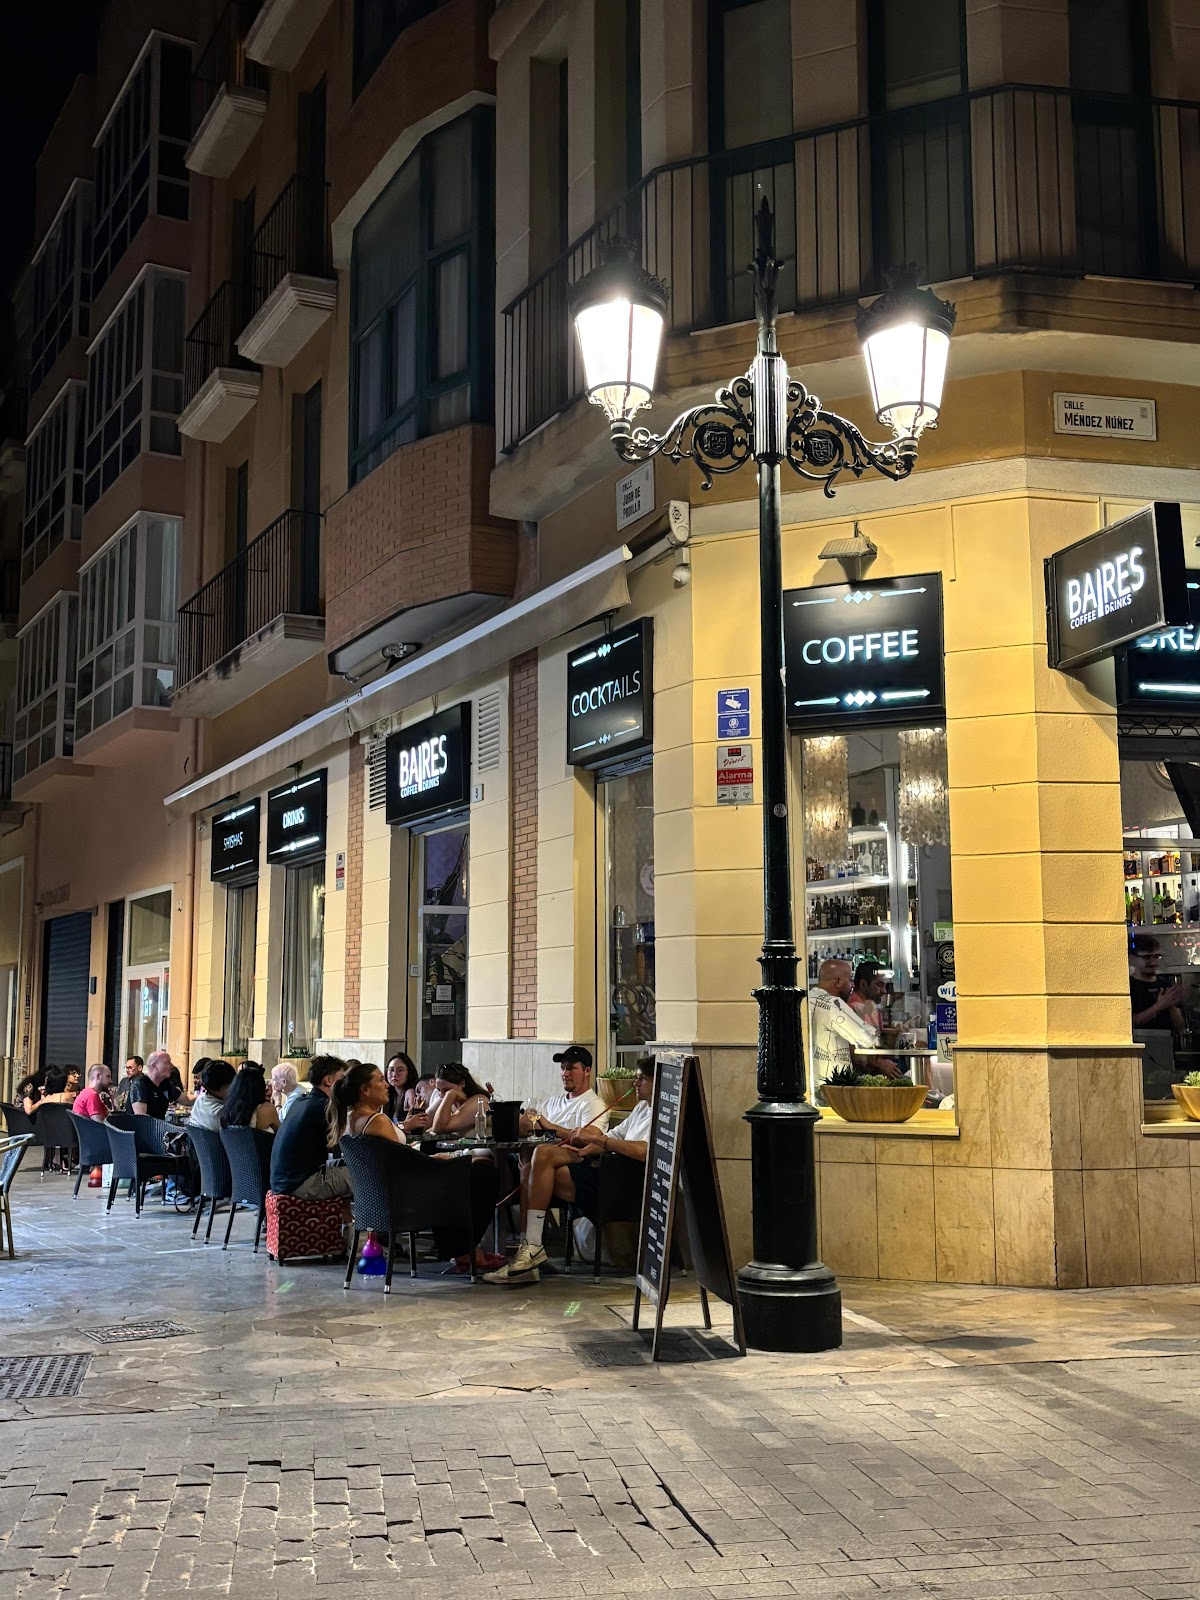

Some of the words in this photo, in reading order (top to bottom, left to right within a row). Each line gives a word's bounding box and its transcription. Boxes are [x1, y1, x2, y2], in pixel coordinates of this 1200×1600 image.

[1064, 400, 1084, 410] CALLE
[1064, 412, 1102, 428] MÉNDEZ
[1105, 414, 1134, 431] NÚÑEZ
[1067, 546, 1145, 619] BAIRES
[1070, 610, 1097, 630] COFFEE
[1104, 593, 1132, 615] DRINKS
[802, 629, 919, 665] COFFEE
[571, 670, 640, 717] COCKTAILS
[399, 735, 447, 792] BAIRES
[401, 784, 418, 798] COFFEE
[422, 776, 440, 791] DRINKS
[718, 771, 752, 781] Alarma
[282, 806, 304, 829] DRINKS
[223, 831, 244, 851] SHISHAS
